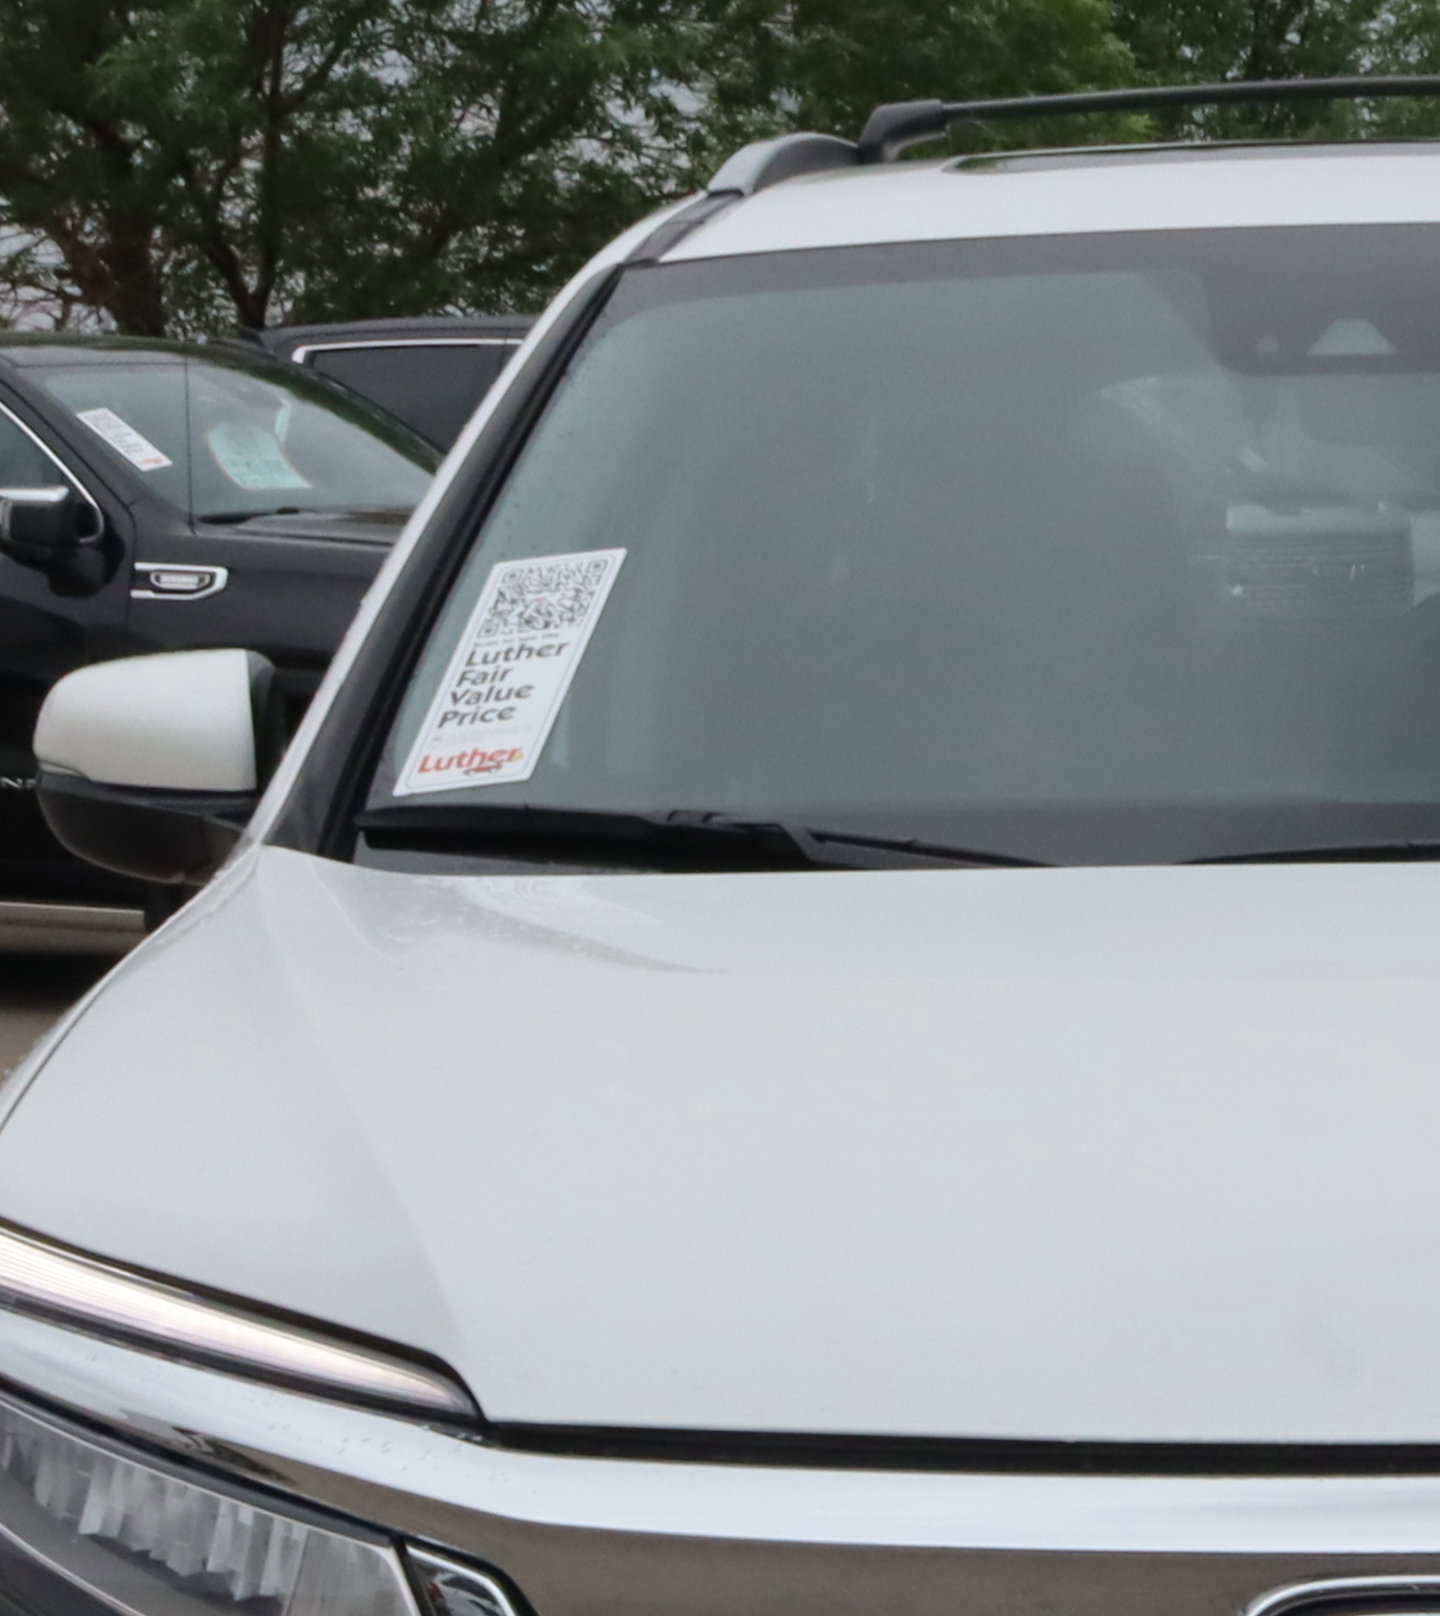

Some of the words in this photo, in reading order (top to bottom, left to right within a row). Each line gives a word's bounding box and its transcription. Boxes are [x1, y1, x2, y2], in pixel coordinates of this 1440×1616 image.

[464, 642, 570, 668] Luther
[455, 665, 513, 689] Fair
[450, 683, 535, 707] Value
[437, 705, 517, 729] Price
[417, 747, 524, 774] Luther
